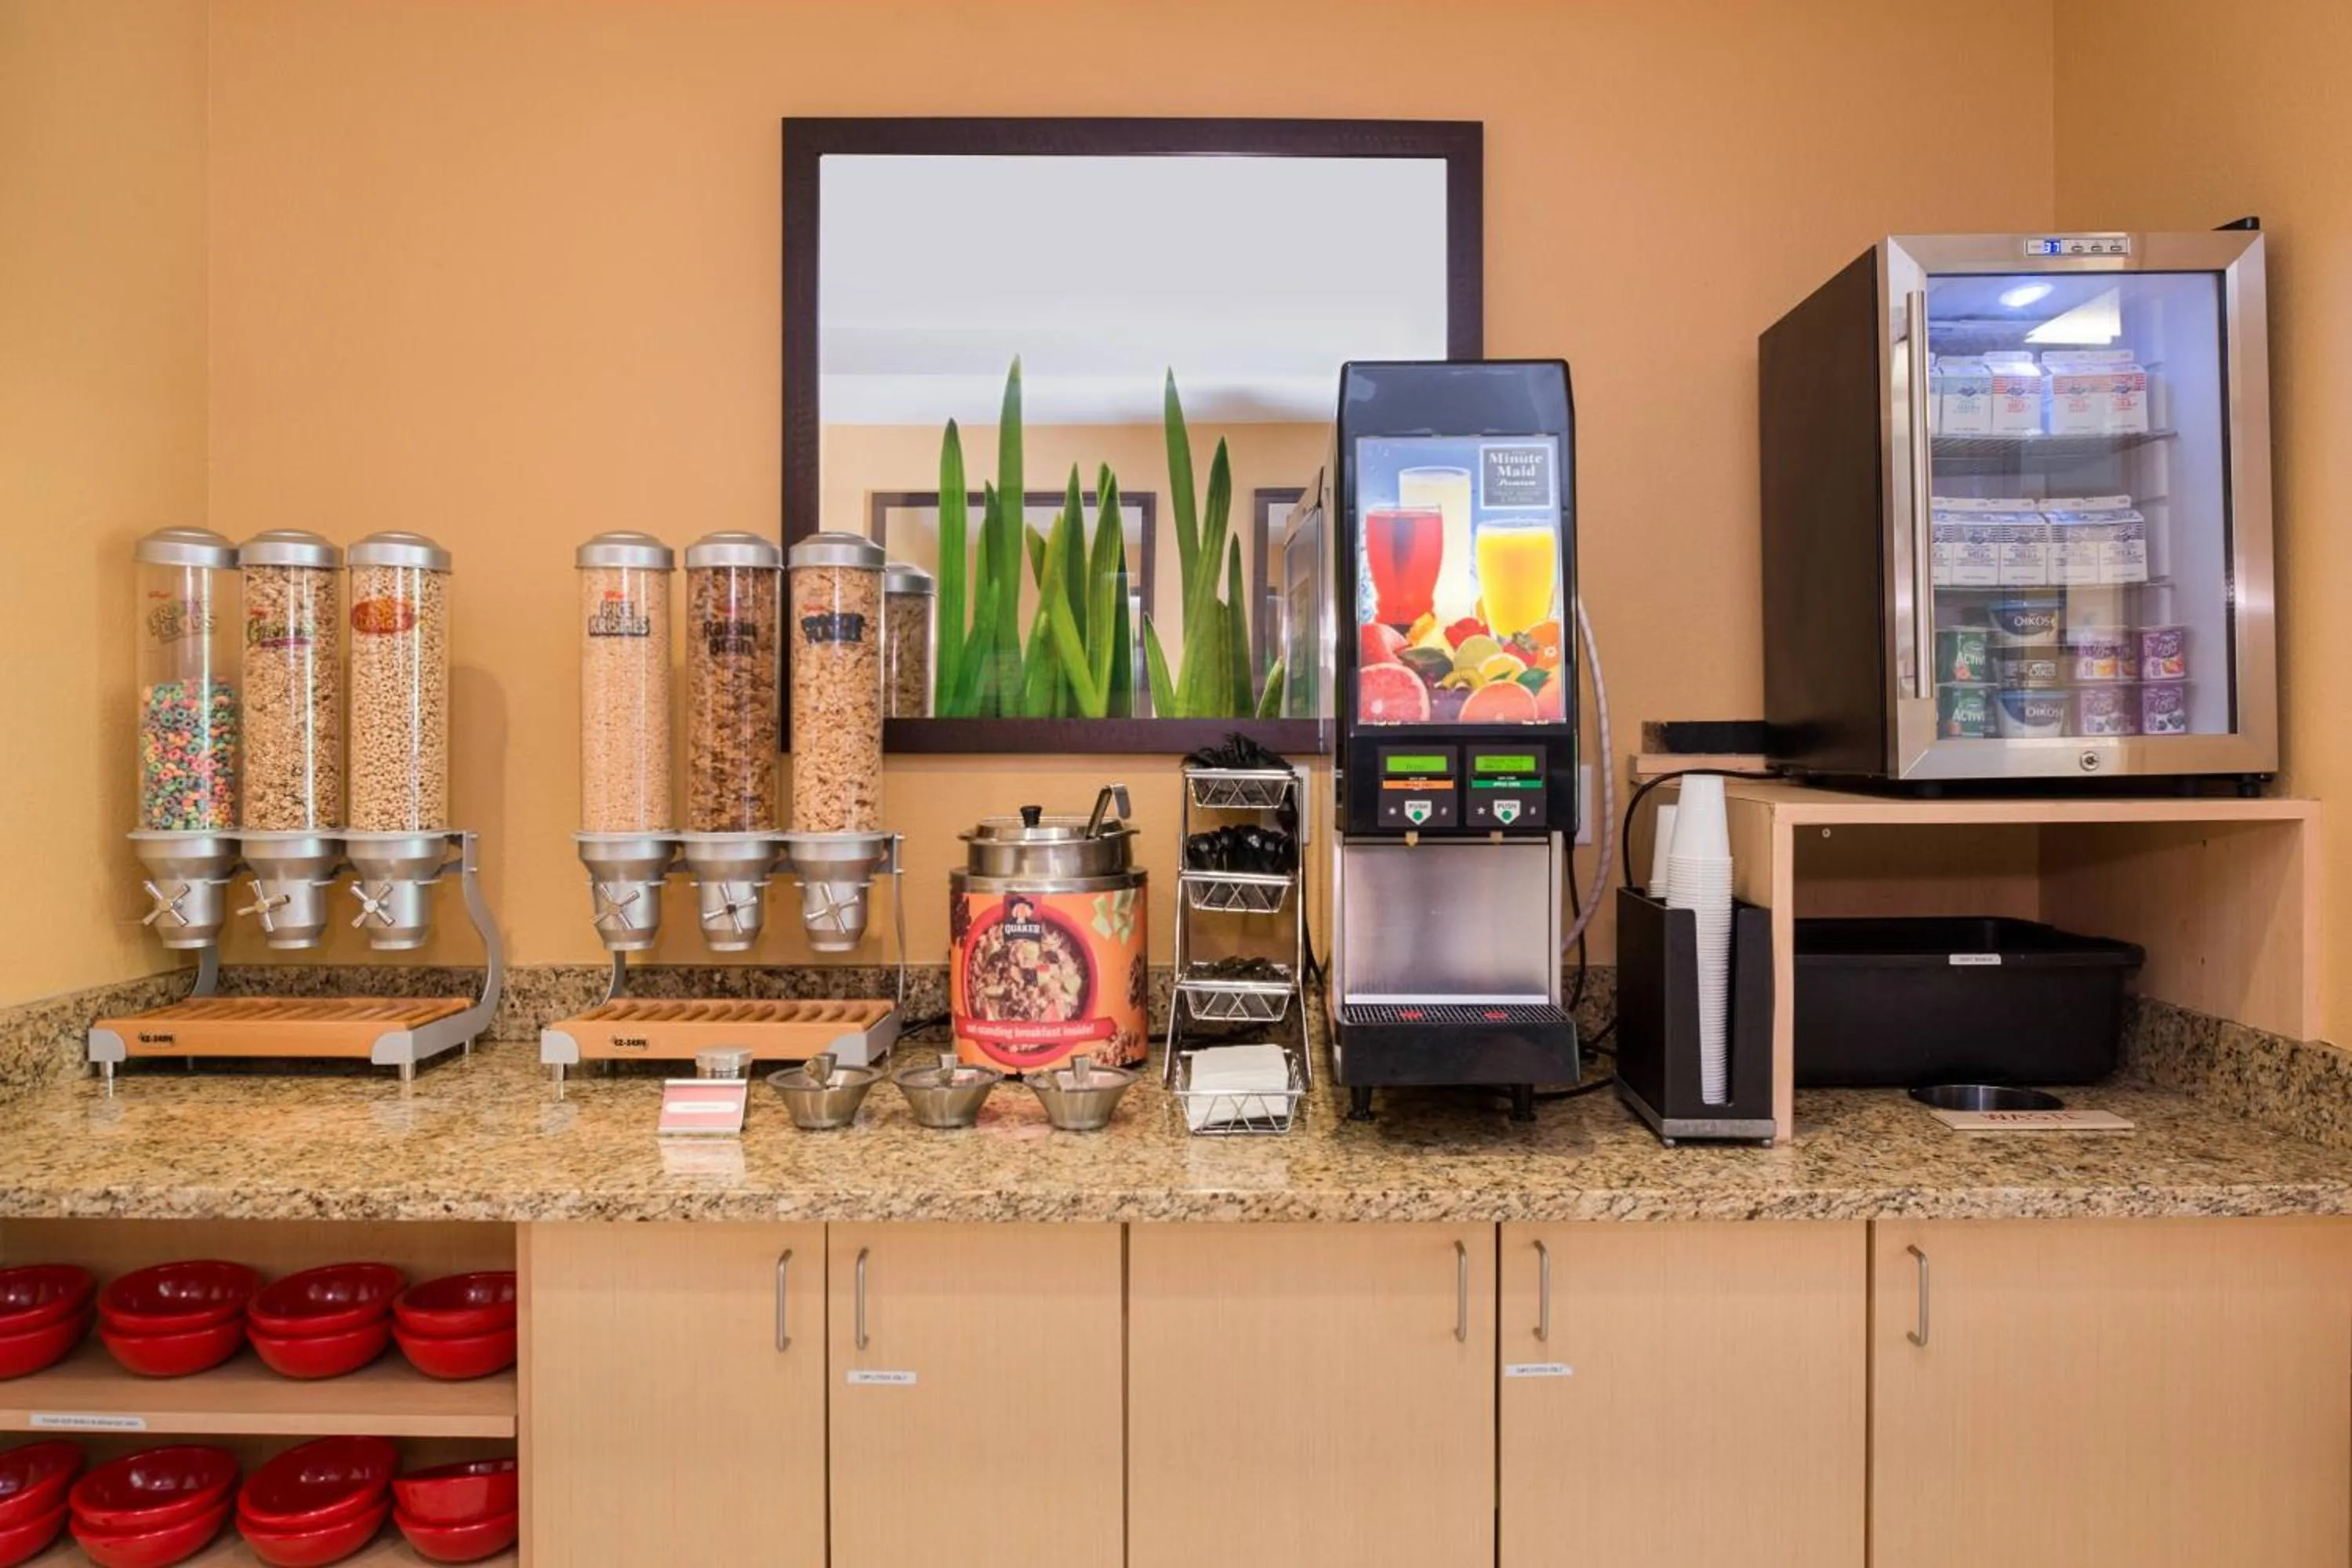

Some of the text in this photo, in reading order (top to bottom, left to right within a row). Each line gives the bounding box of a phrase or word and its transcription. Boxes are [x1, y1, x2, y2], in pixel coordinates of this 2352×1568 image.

[2044, 241, 2060, 252] 37
[1489, 452, 1544, 464] Minute
[1497, 464, 1536, 477] Maid
[2013, 615, 2050, 626] OIKOS
[1004, 924, 1041, 935] QUAKER
